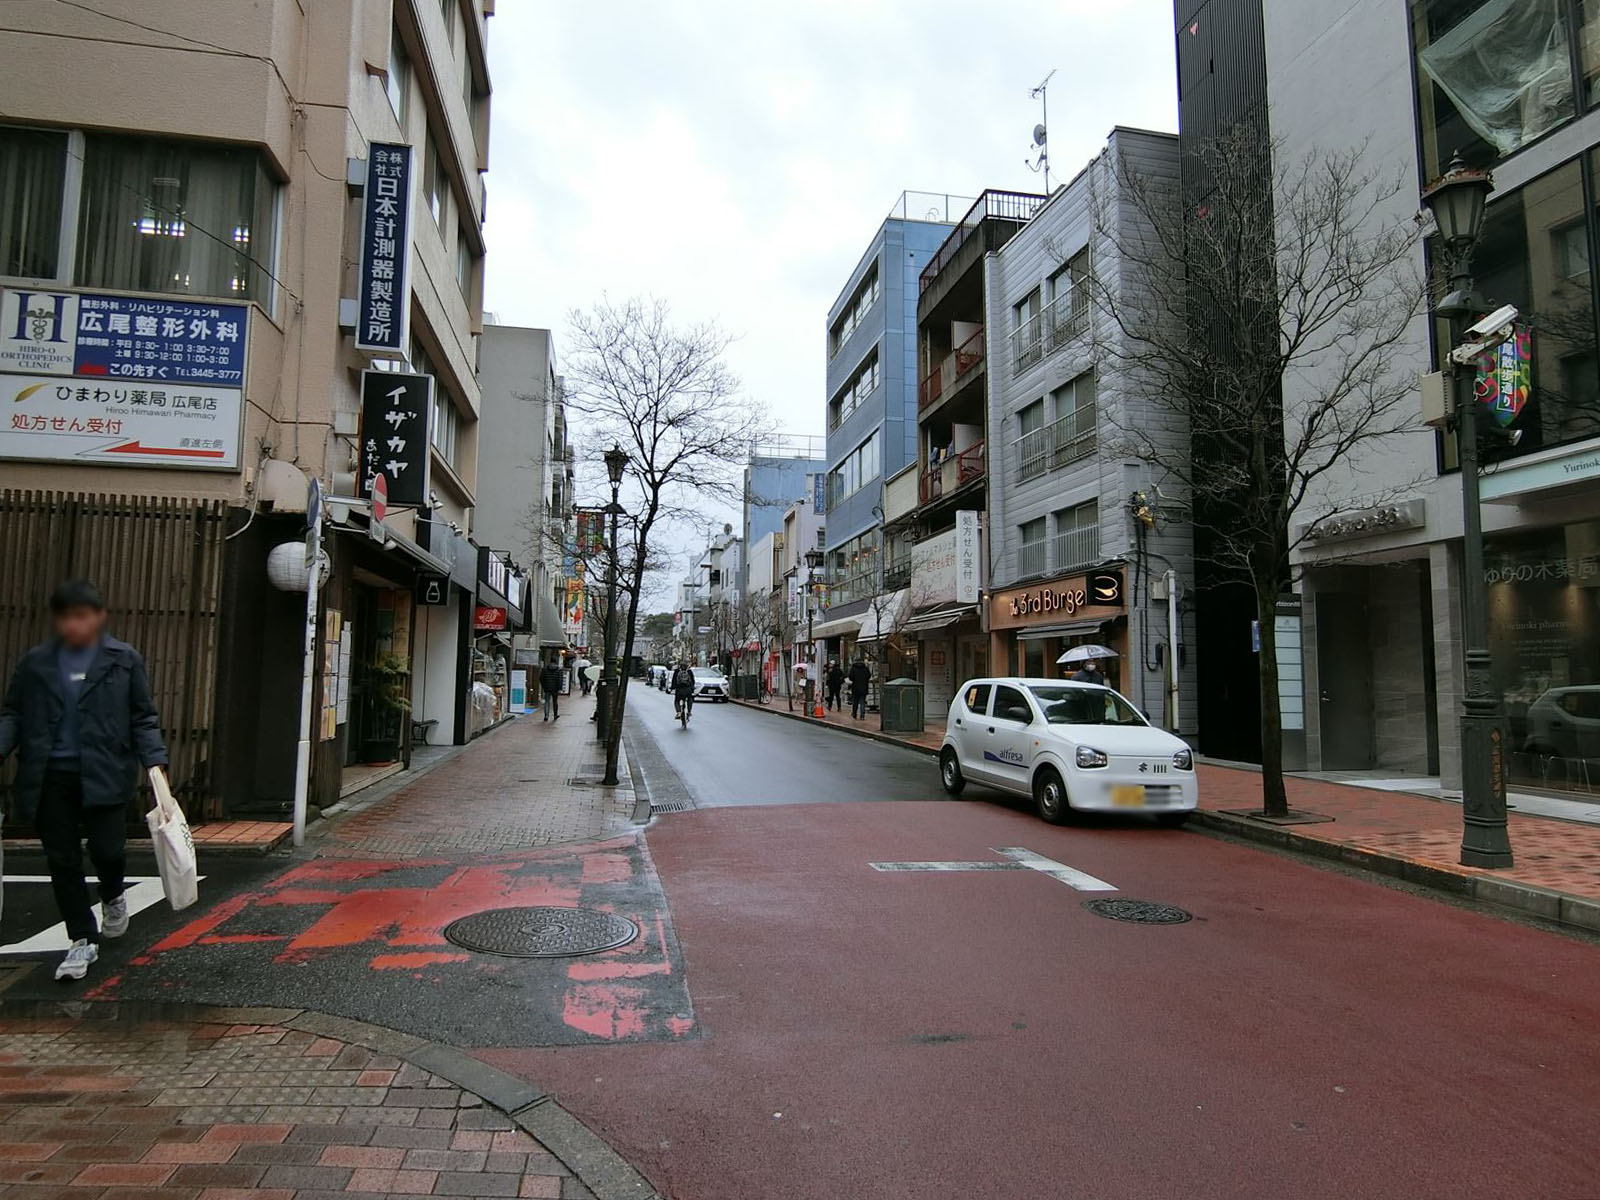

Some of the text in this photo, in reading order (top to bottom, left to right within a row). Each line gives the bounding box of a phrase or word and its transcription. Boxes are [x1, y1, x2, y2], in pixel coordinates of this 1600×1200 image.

[367, 176, 398, 343] 日本計測器製造所
[79, 311, 239, 343] 広尾整形外科
[1, 351, 72, 362] ORTHOPEDICS
[20, 345, 56, 354] HIRO-O
[19, 360, 53, 369] CLINIC
[109, 363, 169, 378] この先すぐ
[1501, 337, 1516, 408] 尾散歩通り
[56, 386, 218, 411] ひまわり薬局 広尾店
[11, 413, 123, 435] 処方せん受付
[106, 406, 216, 421] Hiroo Himawari Pharmacy
[385, 385, 418, 479] イザカヤ
[962, 515, 973, 580] 処方せん受付
[1484, 556, 1598, 587] ゆりの木薬局
[1020, 590, 1042, 614] 3rd
[999, 747, 1024, 762] alfresa
